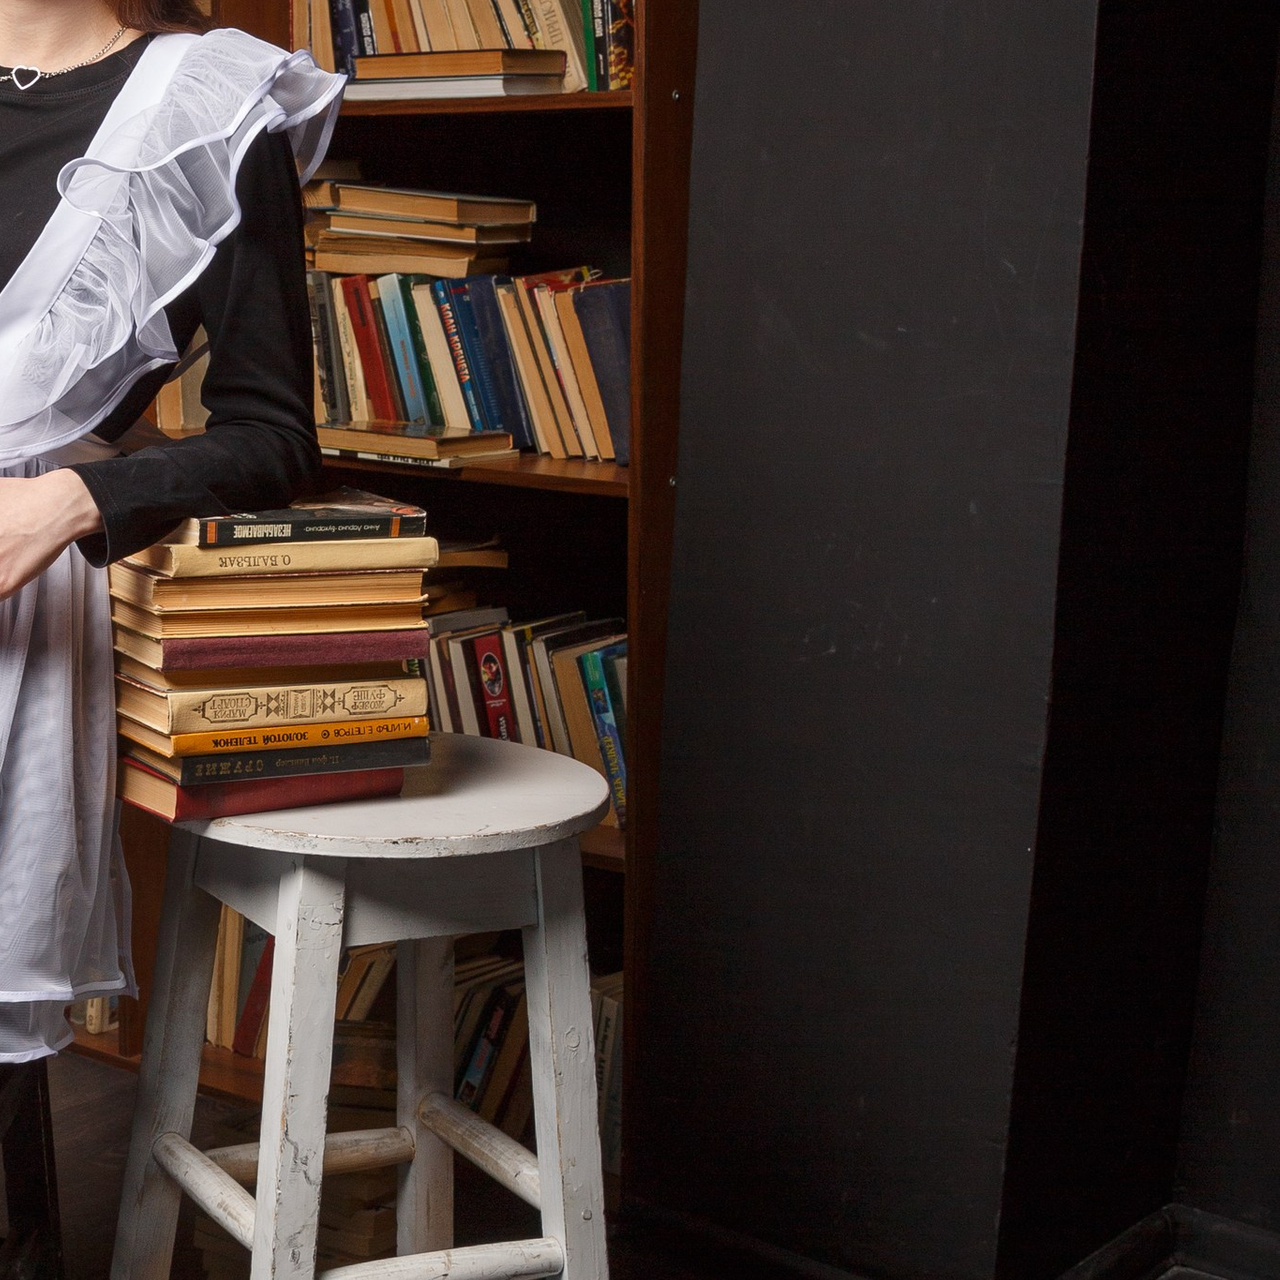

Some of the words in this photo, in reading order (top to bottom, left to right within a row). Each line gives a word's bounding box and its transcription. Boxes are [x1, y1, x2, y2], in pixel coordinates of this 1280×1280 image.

[440, 303, 457, 333] КЛАН
[450, 334, 471, 384] КРЕЧЕТА
[233, 523, 292, 539] НЕЗАБЫВАЕМОЕ
[218, 556, 279, 568] БАЛЬЗАК
[352, 690, 386, 701] ФУШЕ
[209, 699, 252, 710] СТЮАРТ
[351, 700, 385, 710] ЖОЗЕФ
[213, 708, 247, 718] МАРИЯ
[212, 736, 258, 748] ТЕЛЕНОК
[262, 731, 308, 744] ЗОЛОТОЙ
[195, 759, 264, 777] ОРУЖИЕ
